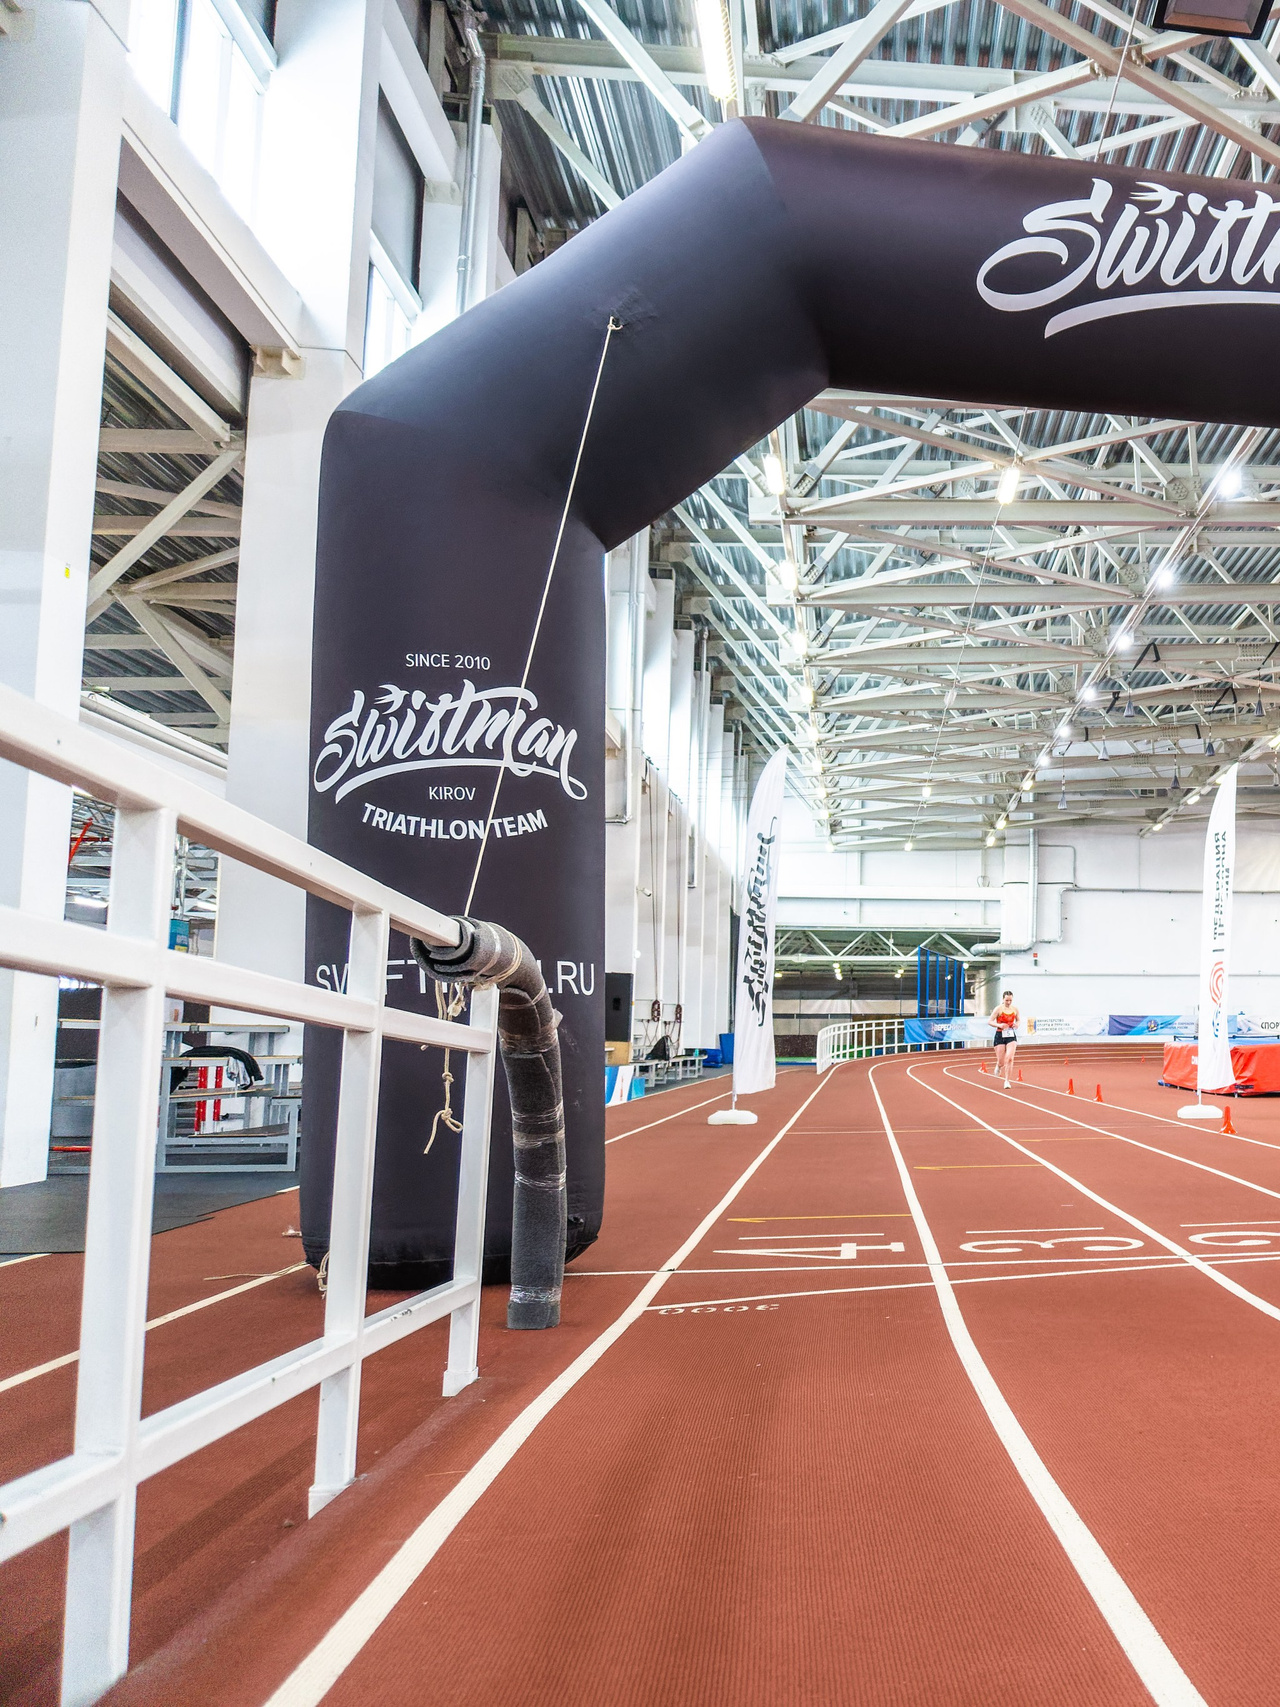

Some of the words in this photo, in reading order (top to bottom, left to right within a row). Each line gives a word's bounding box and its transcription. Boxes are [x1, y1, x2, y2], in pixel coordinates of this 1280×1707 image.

[406, 653, 450, 668] SINCE
[455, 655, 491, 670] 2010
[429, 786, 476, 801] KIROV
[361, 802, 486, 840] TRIATHLON
[489, 808, 549, 839] TEAM
[713, 1242, 905, 1260] 4
[959, 1236, 1144, 1253] 3
